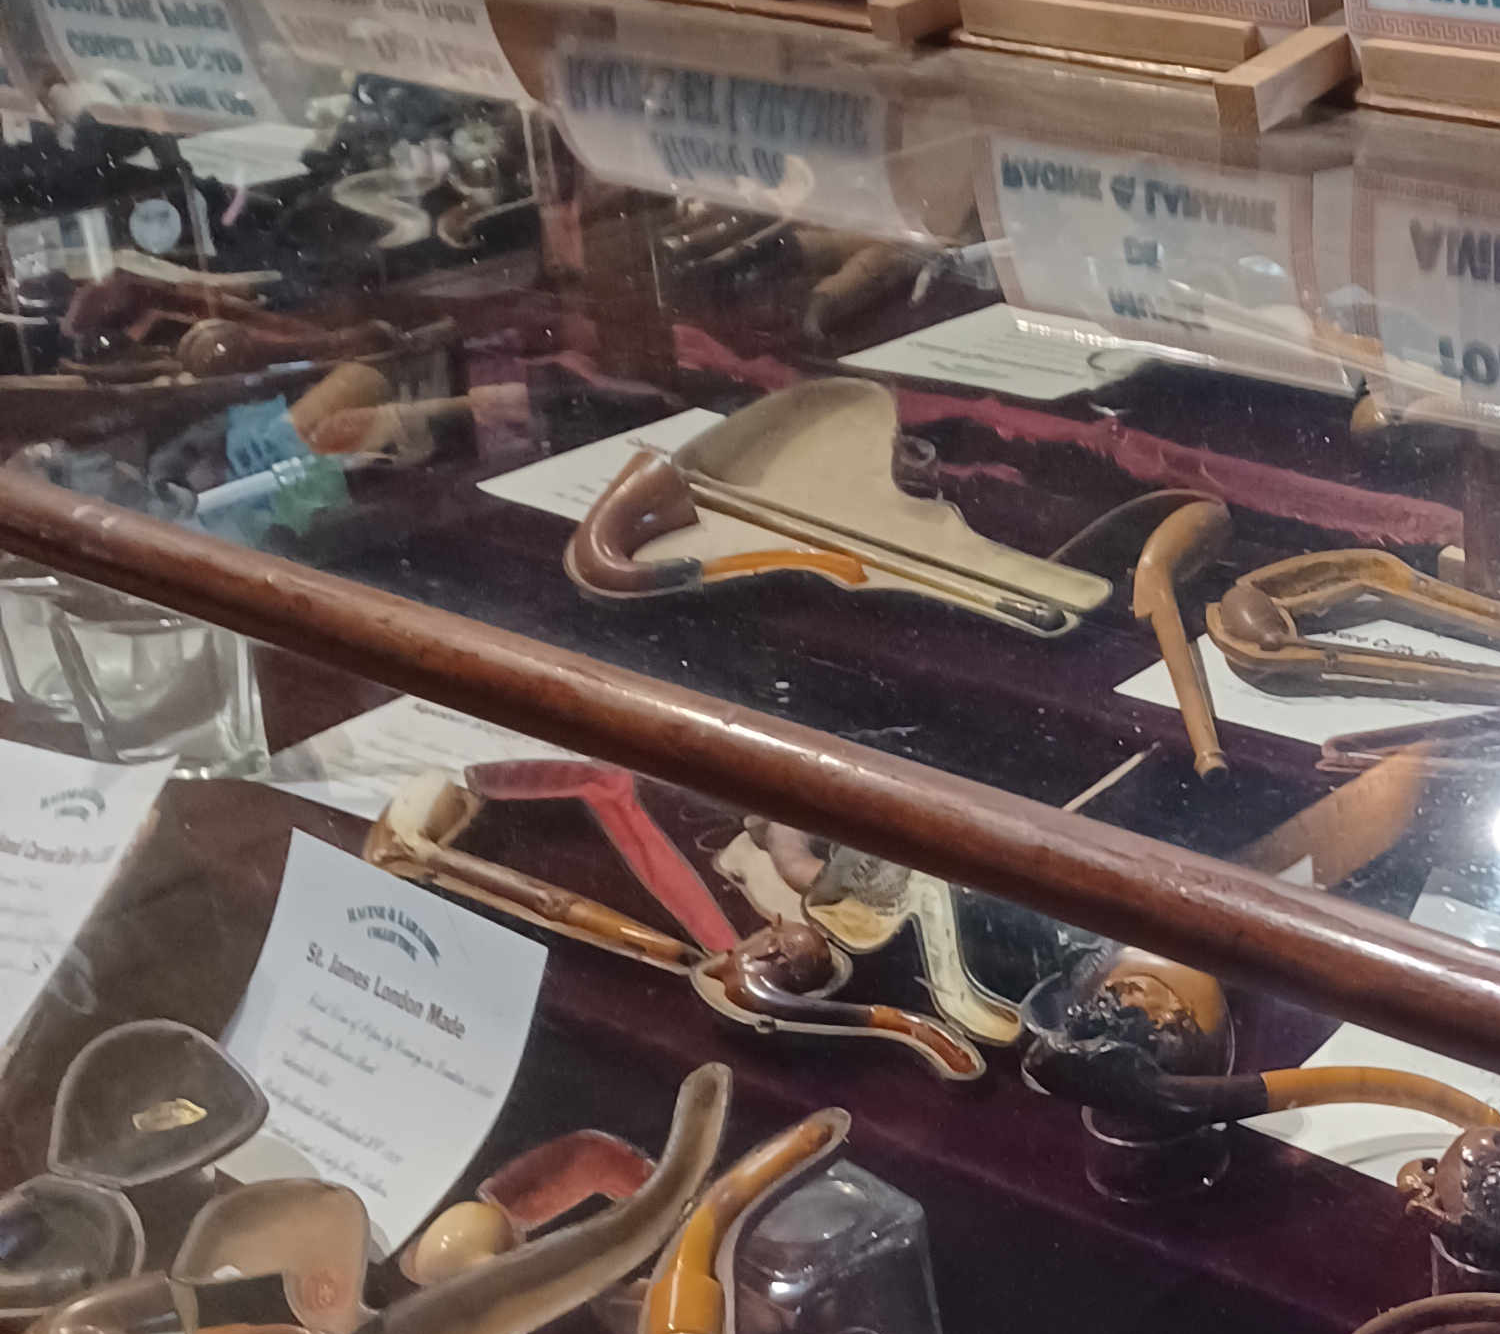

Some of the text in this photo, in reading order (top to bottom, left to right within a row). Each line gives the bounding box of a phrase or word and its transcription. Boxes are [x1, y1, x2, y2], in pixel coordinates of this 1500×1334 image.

[306, 940, 325, 971] St.
[327, 954, 371, 991] James
[372, 975, 424, 1020] London
[425, 1001, 467, 1040] Made
